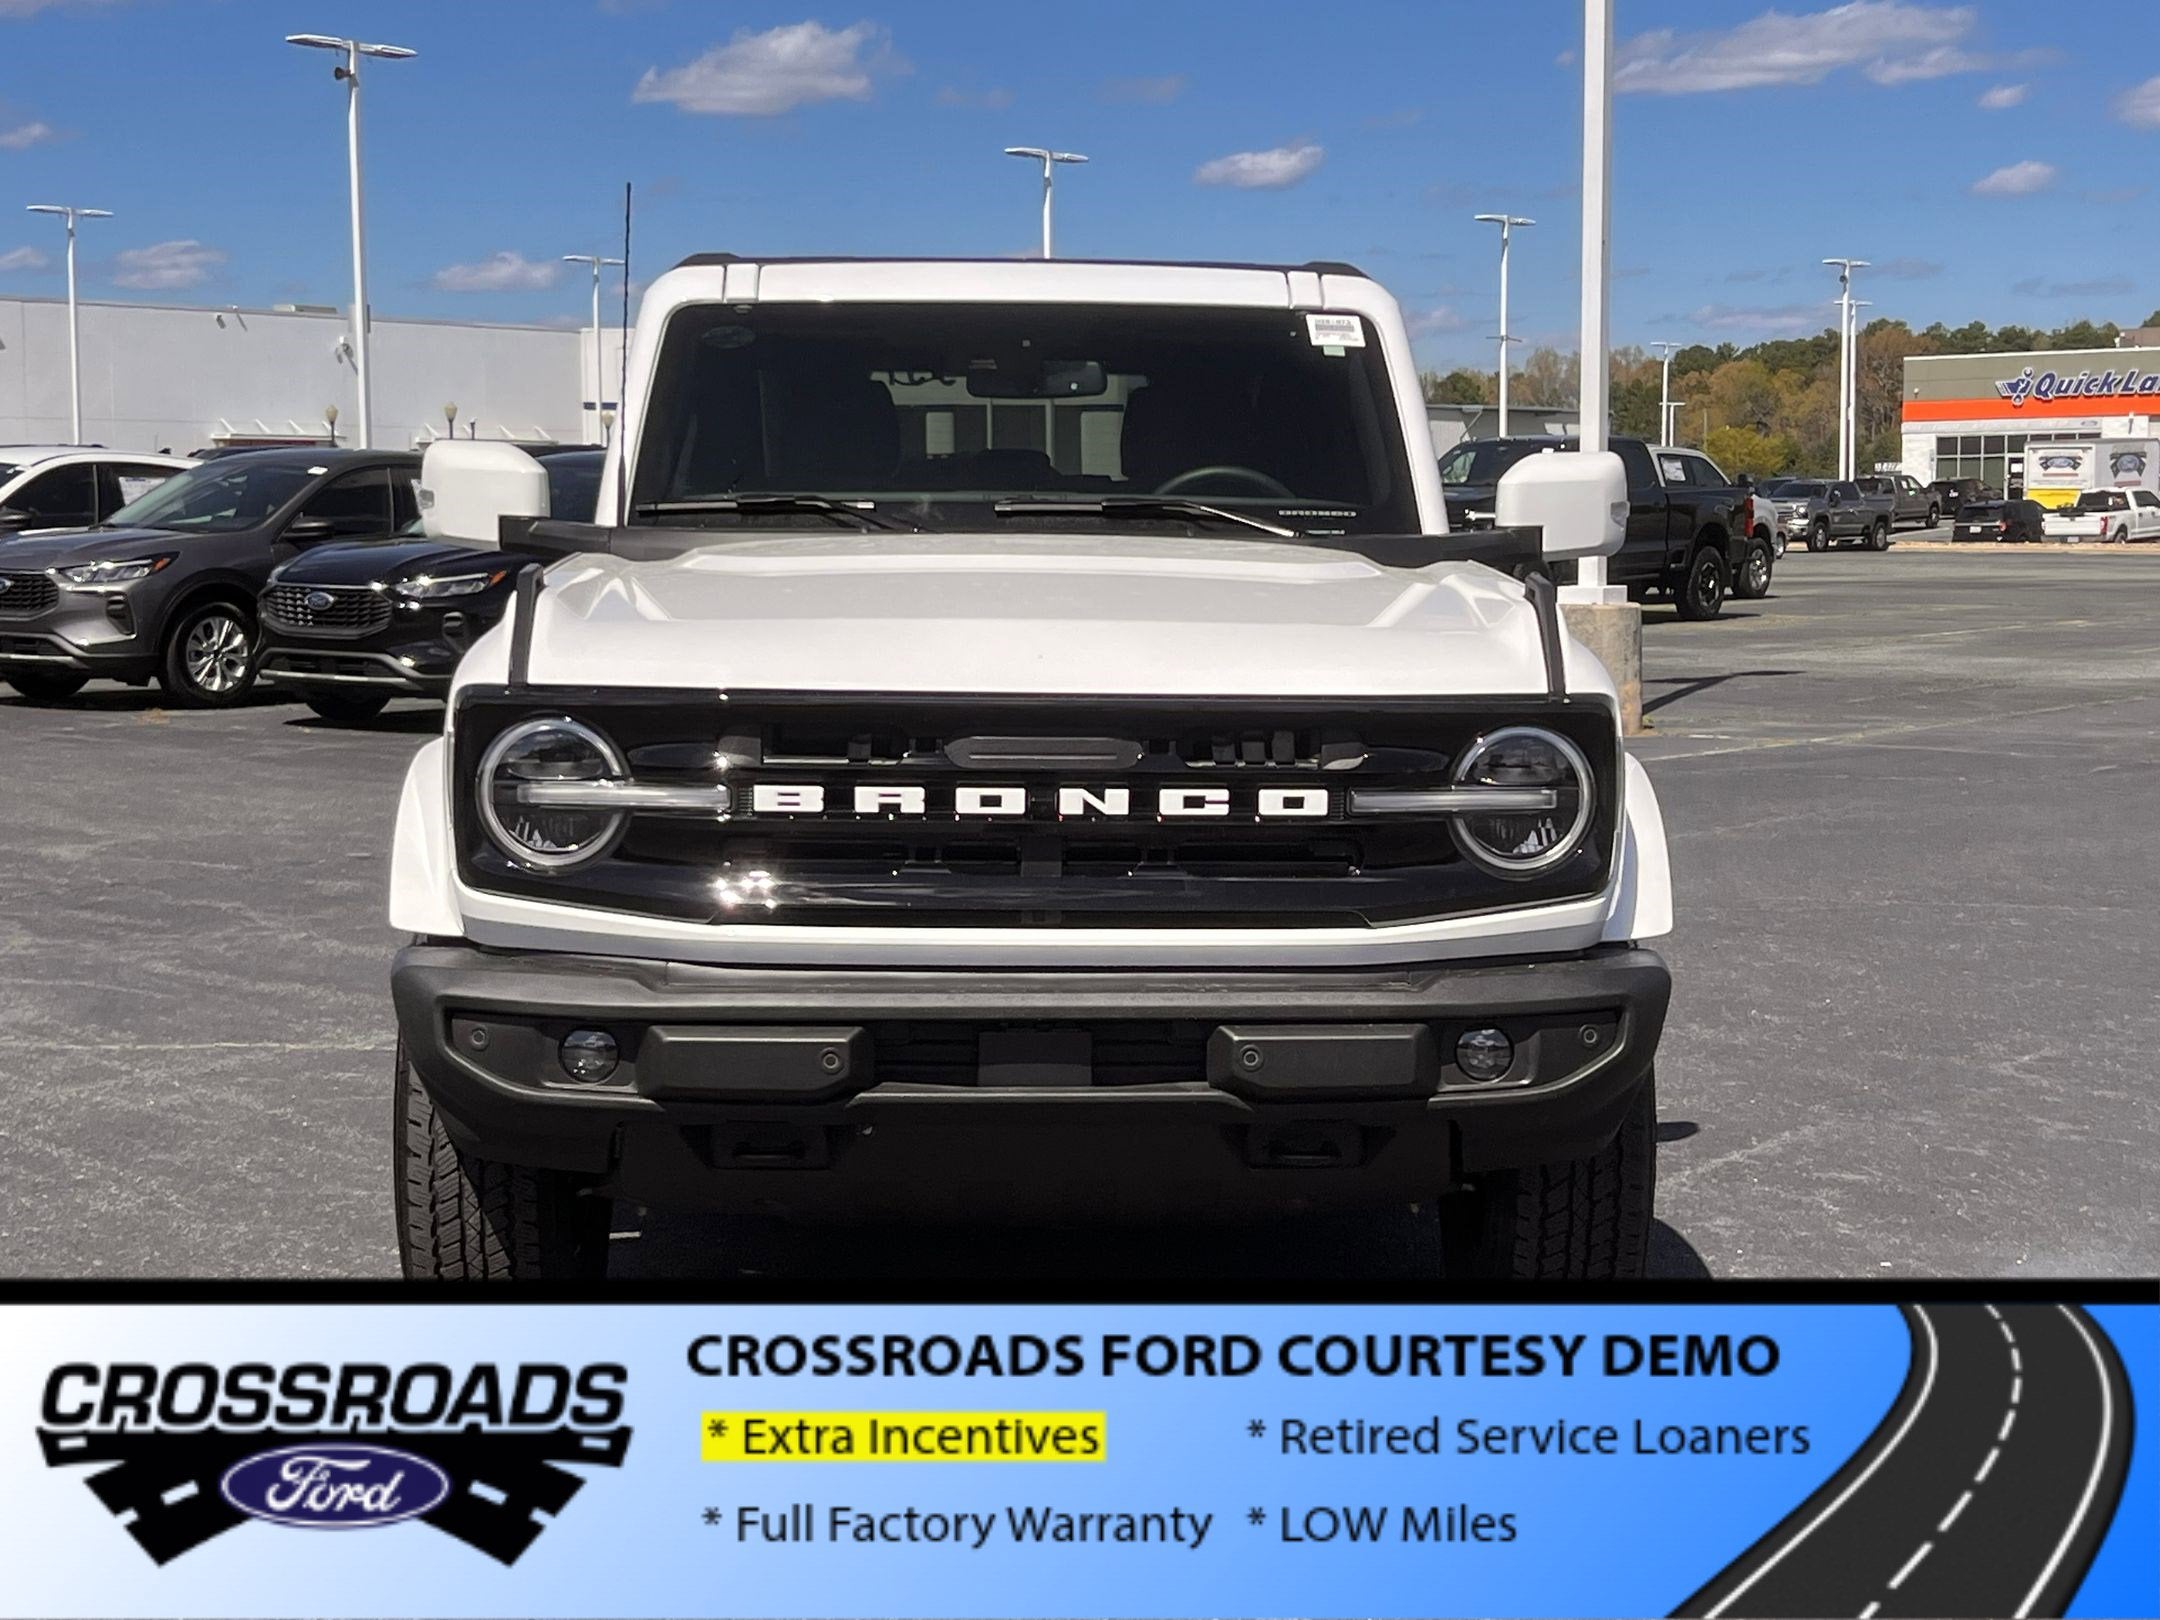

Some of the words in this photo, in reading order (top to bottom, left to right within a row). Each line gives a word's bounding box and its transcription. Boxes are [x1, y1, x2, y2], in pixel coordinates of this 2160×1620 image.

[2033, 369, 2121, 401] Quick
[2119, 368, 2160, 395] La
[753, 785, 1328, 816] BRONCO
